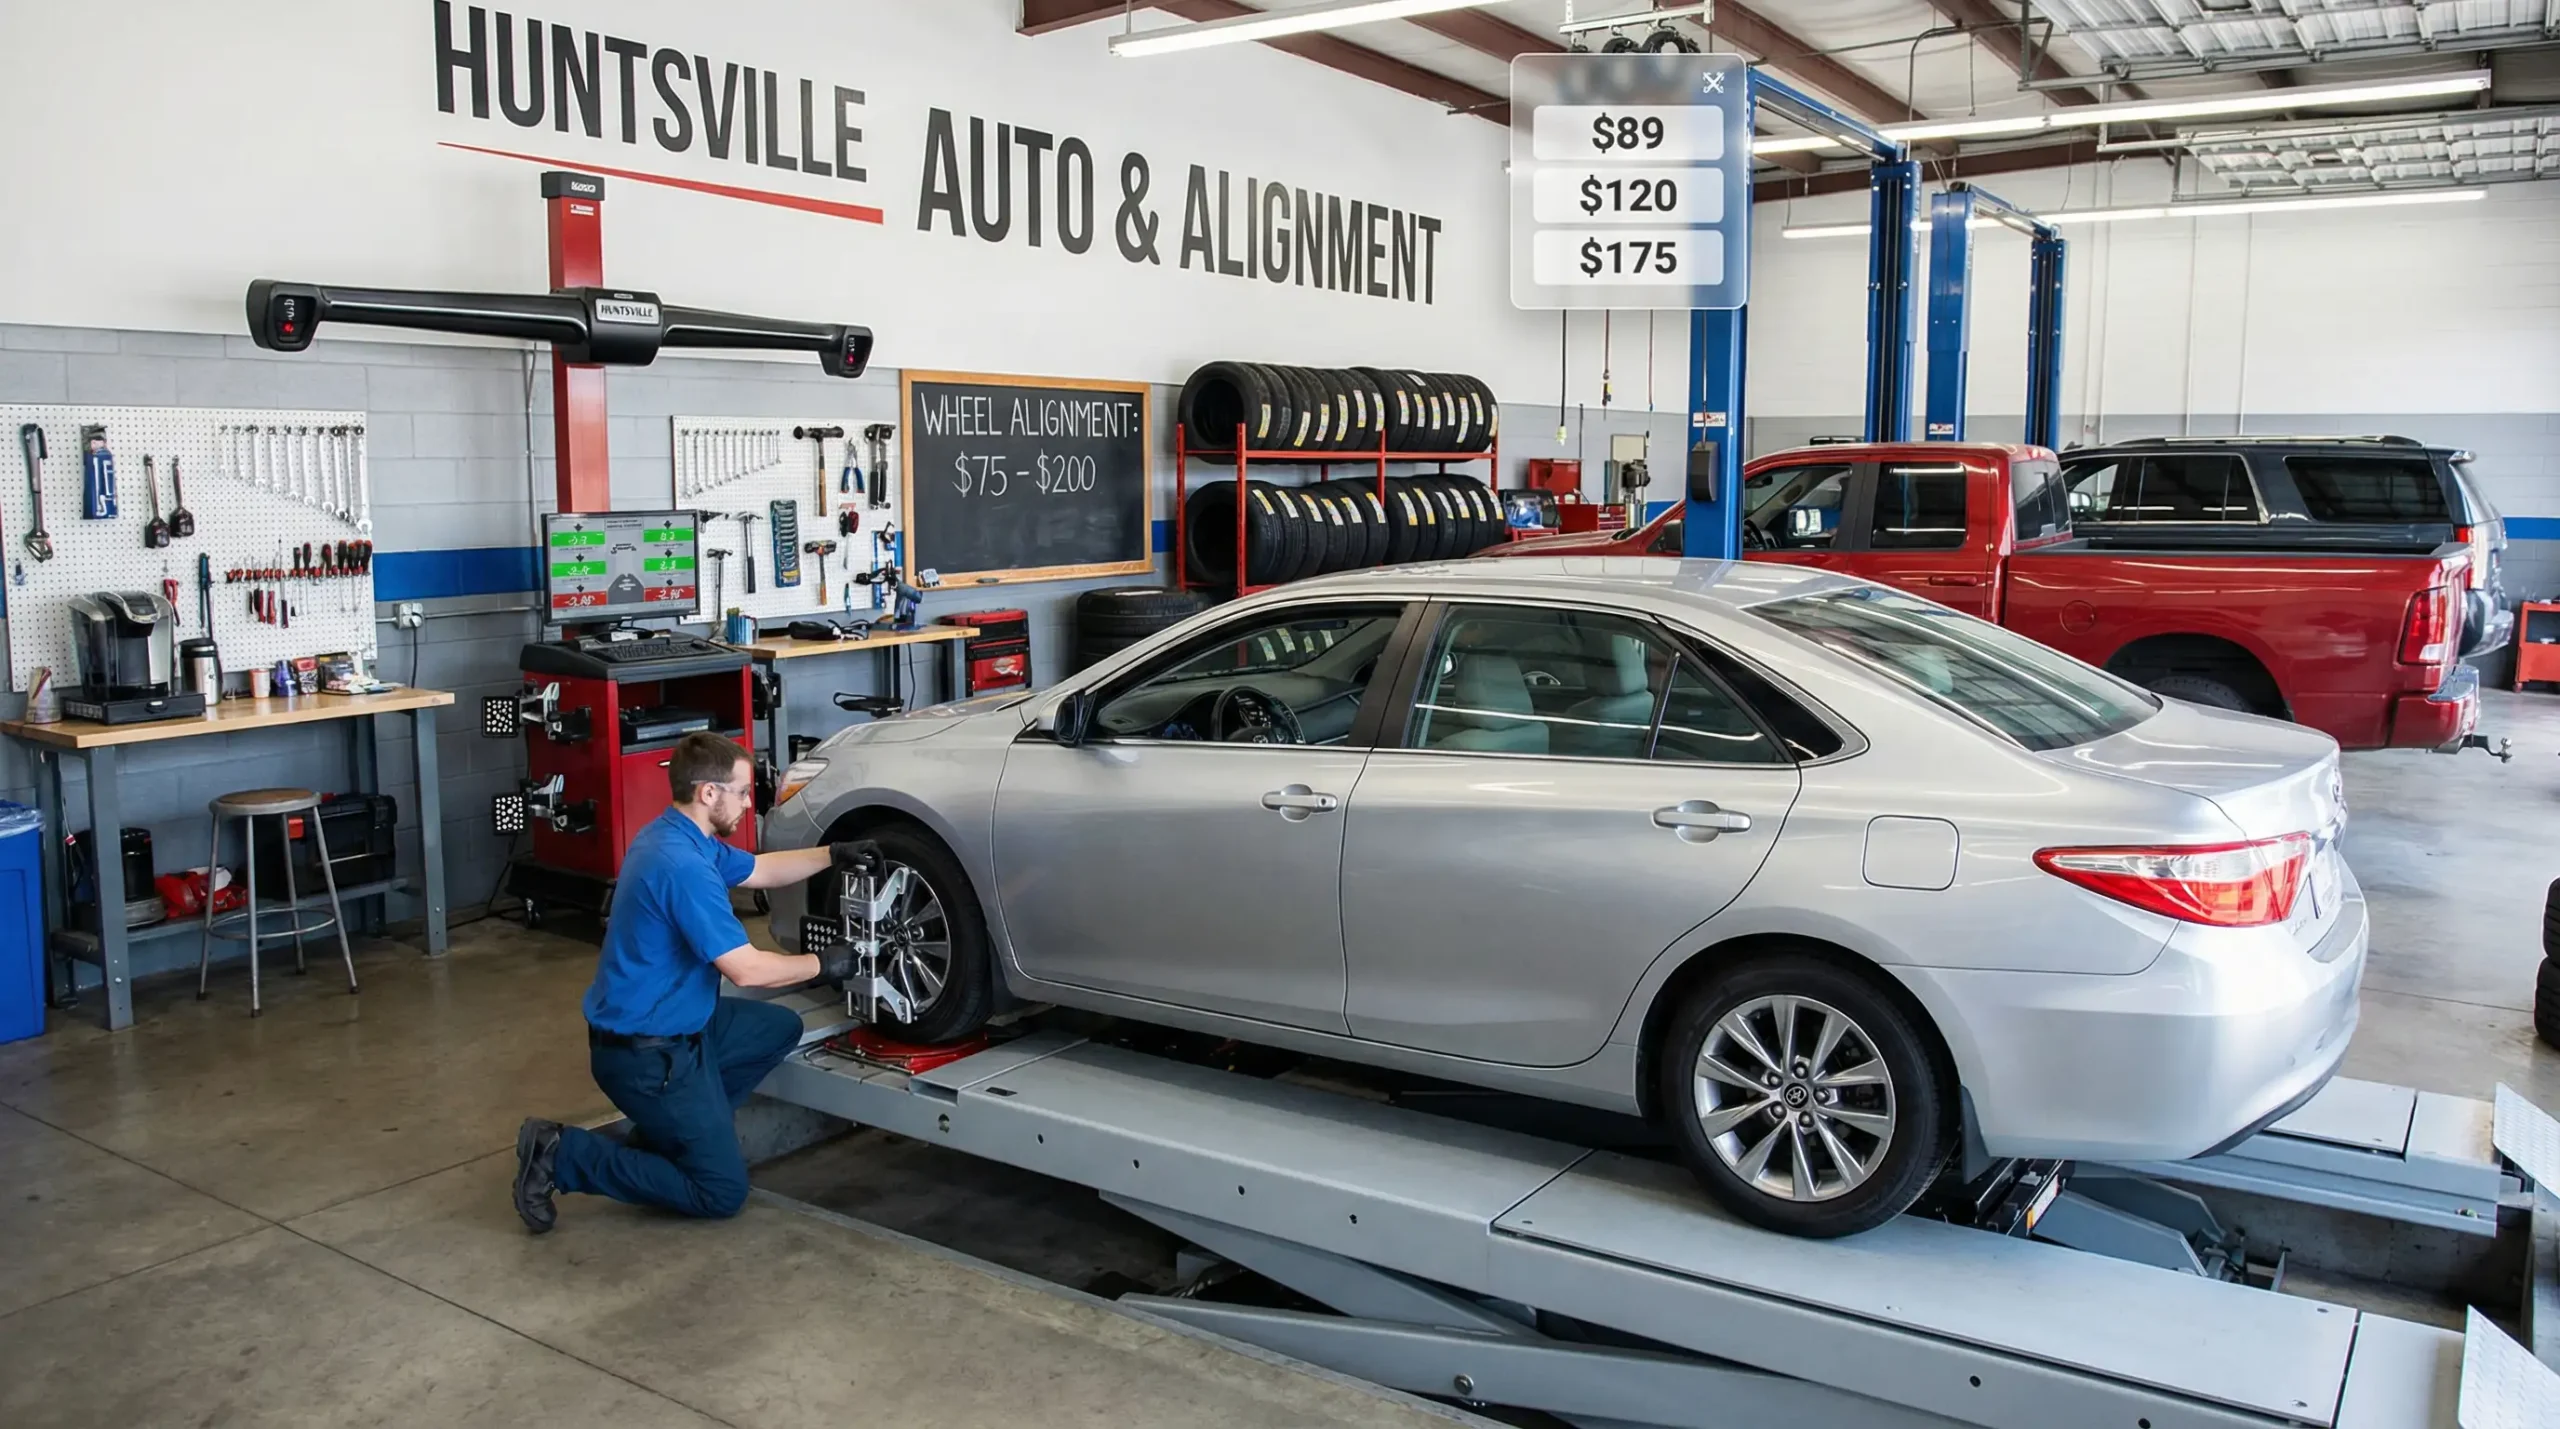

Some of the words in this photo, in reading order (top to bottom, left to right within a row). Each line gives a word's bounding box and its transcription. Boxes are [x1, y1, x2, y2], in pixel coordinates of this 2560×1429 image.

[433, 0, 867, 183] HUNTSVILLE
[917, 107, 1094, 255] AUTO
[1115, 152, 1161, 265] &
[1179, 164, 1442, 305] ALIGNMENT
[600, 304, 653, 317] HUNTSVILLE
[920, 392, 1003, 436] WHEEL
[1010, 397, 1139, 438] ALIGNMENT:
[952, 450, 1008, 498] $75
[1035, 448, 1096, 494] $200
